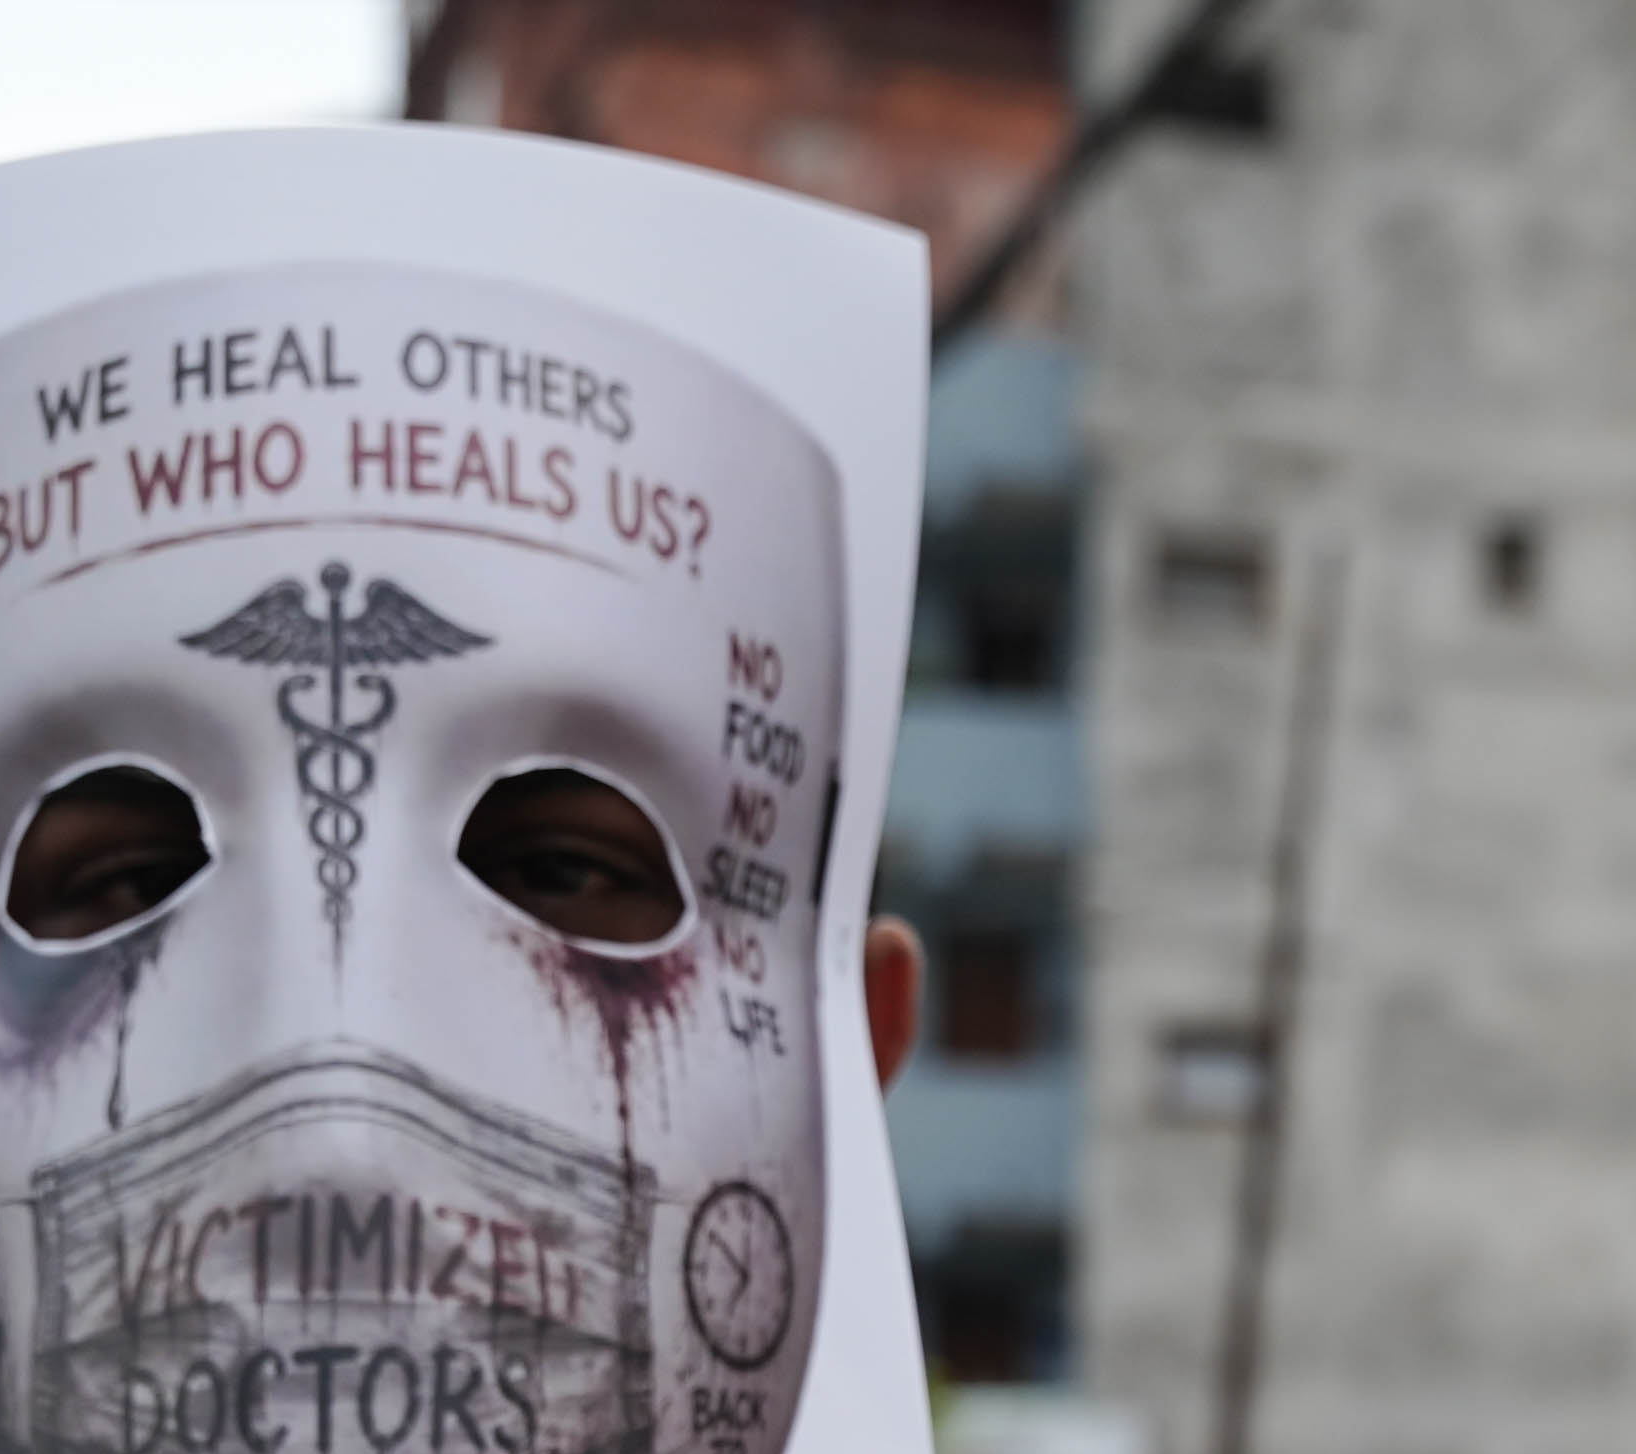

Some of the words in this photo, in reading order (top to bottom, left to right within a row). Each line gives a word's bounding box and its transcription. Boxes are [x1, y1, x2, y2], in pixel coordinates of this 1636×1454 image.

[37, 355, 131, 442] WE
[172, 326, 360, 405] HEAL
[400, 330, 635, 444] OTHERS
[127, 422, 306, 515] WHO
[347, 420, 577, 521] HEALS
[607, 468, 712, 580] US?
[727, 628, 784, 701] NO
[722, 702, 806, 787] FOOD
[724, 782, 777, 848] NO
[714, 920, 766, 985] NO
